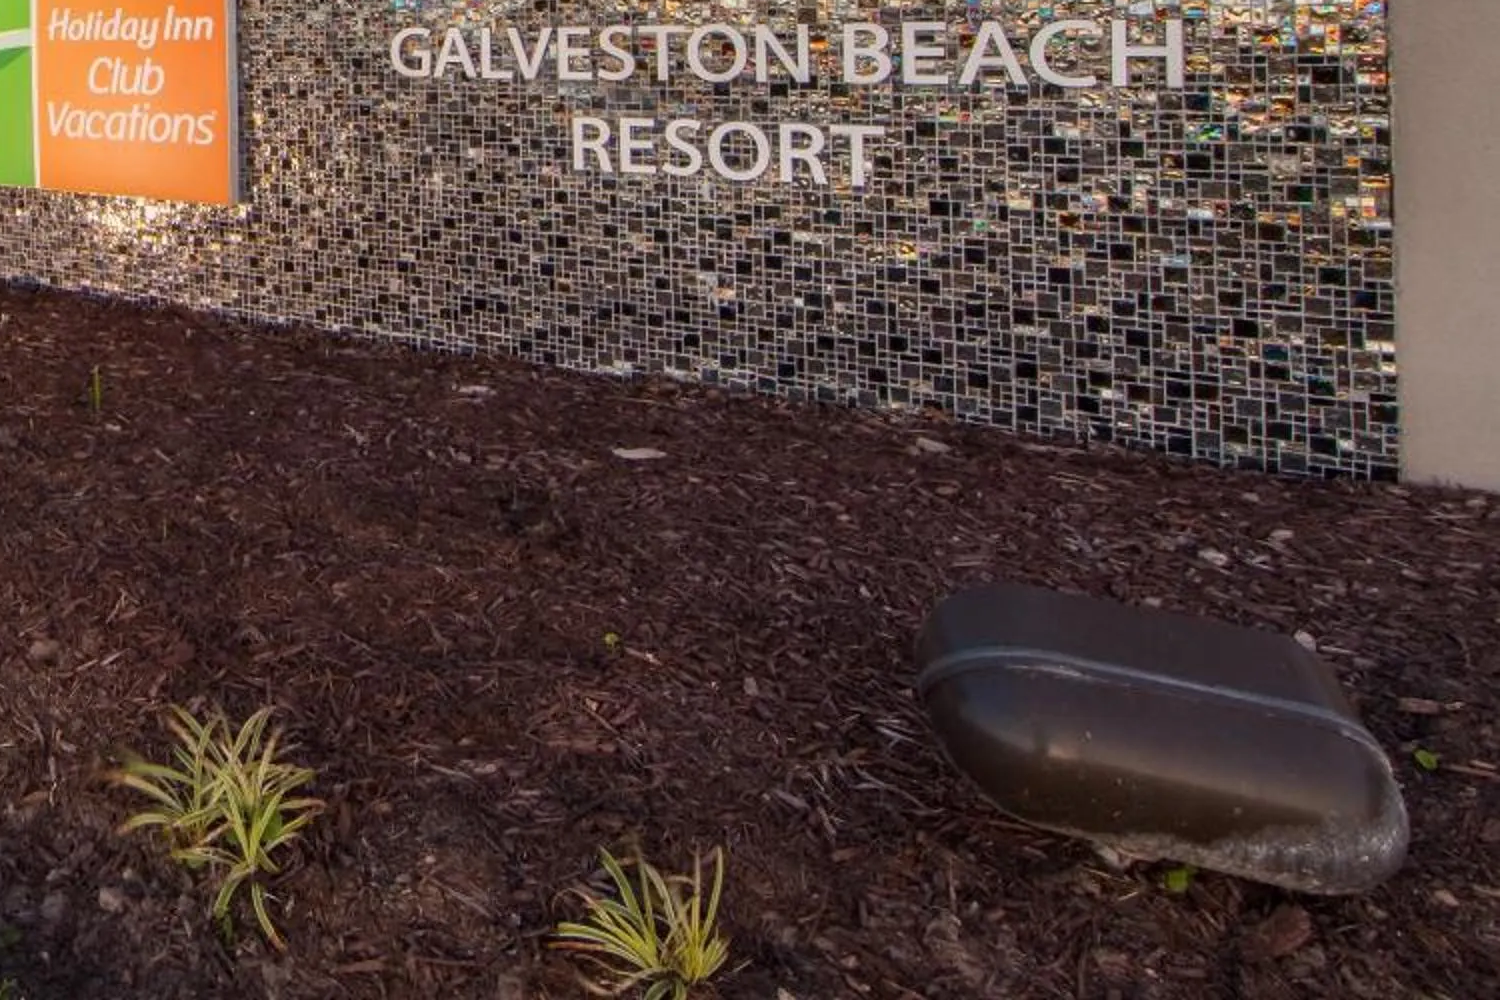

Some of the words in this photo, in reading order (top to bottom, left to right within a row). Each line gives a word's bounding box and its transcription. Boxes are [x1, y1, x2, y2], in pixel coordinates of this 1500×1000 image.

[48, 7, 158, 50] Holiday
[164, 6, 214, 41] Inn
[390, 23, 811, 84] GALVESTON
[843, 18, 1184, 89] BEACH
[87, 56, 165, 97] Club
[47, 101, 215, 146] Vacations
[571, 116, 885, 188] RESORT
